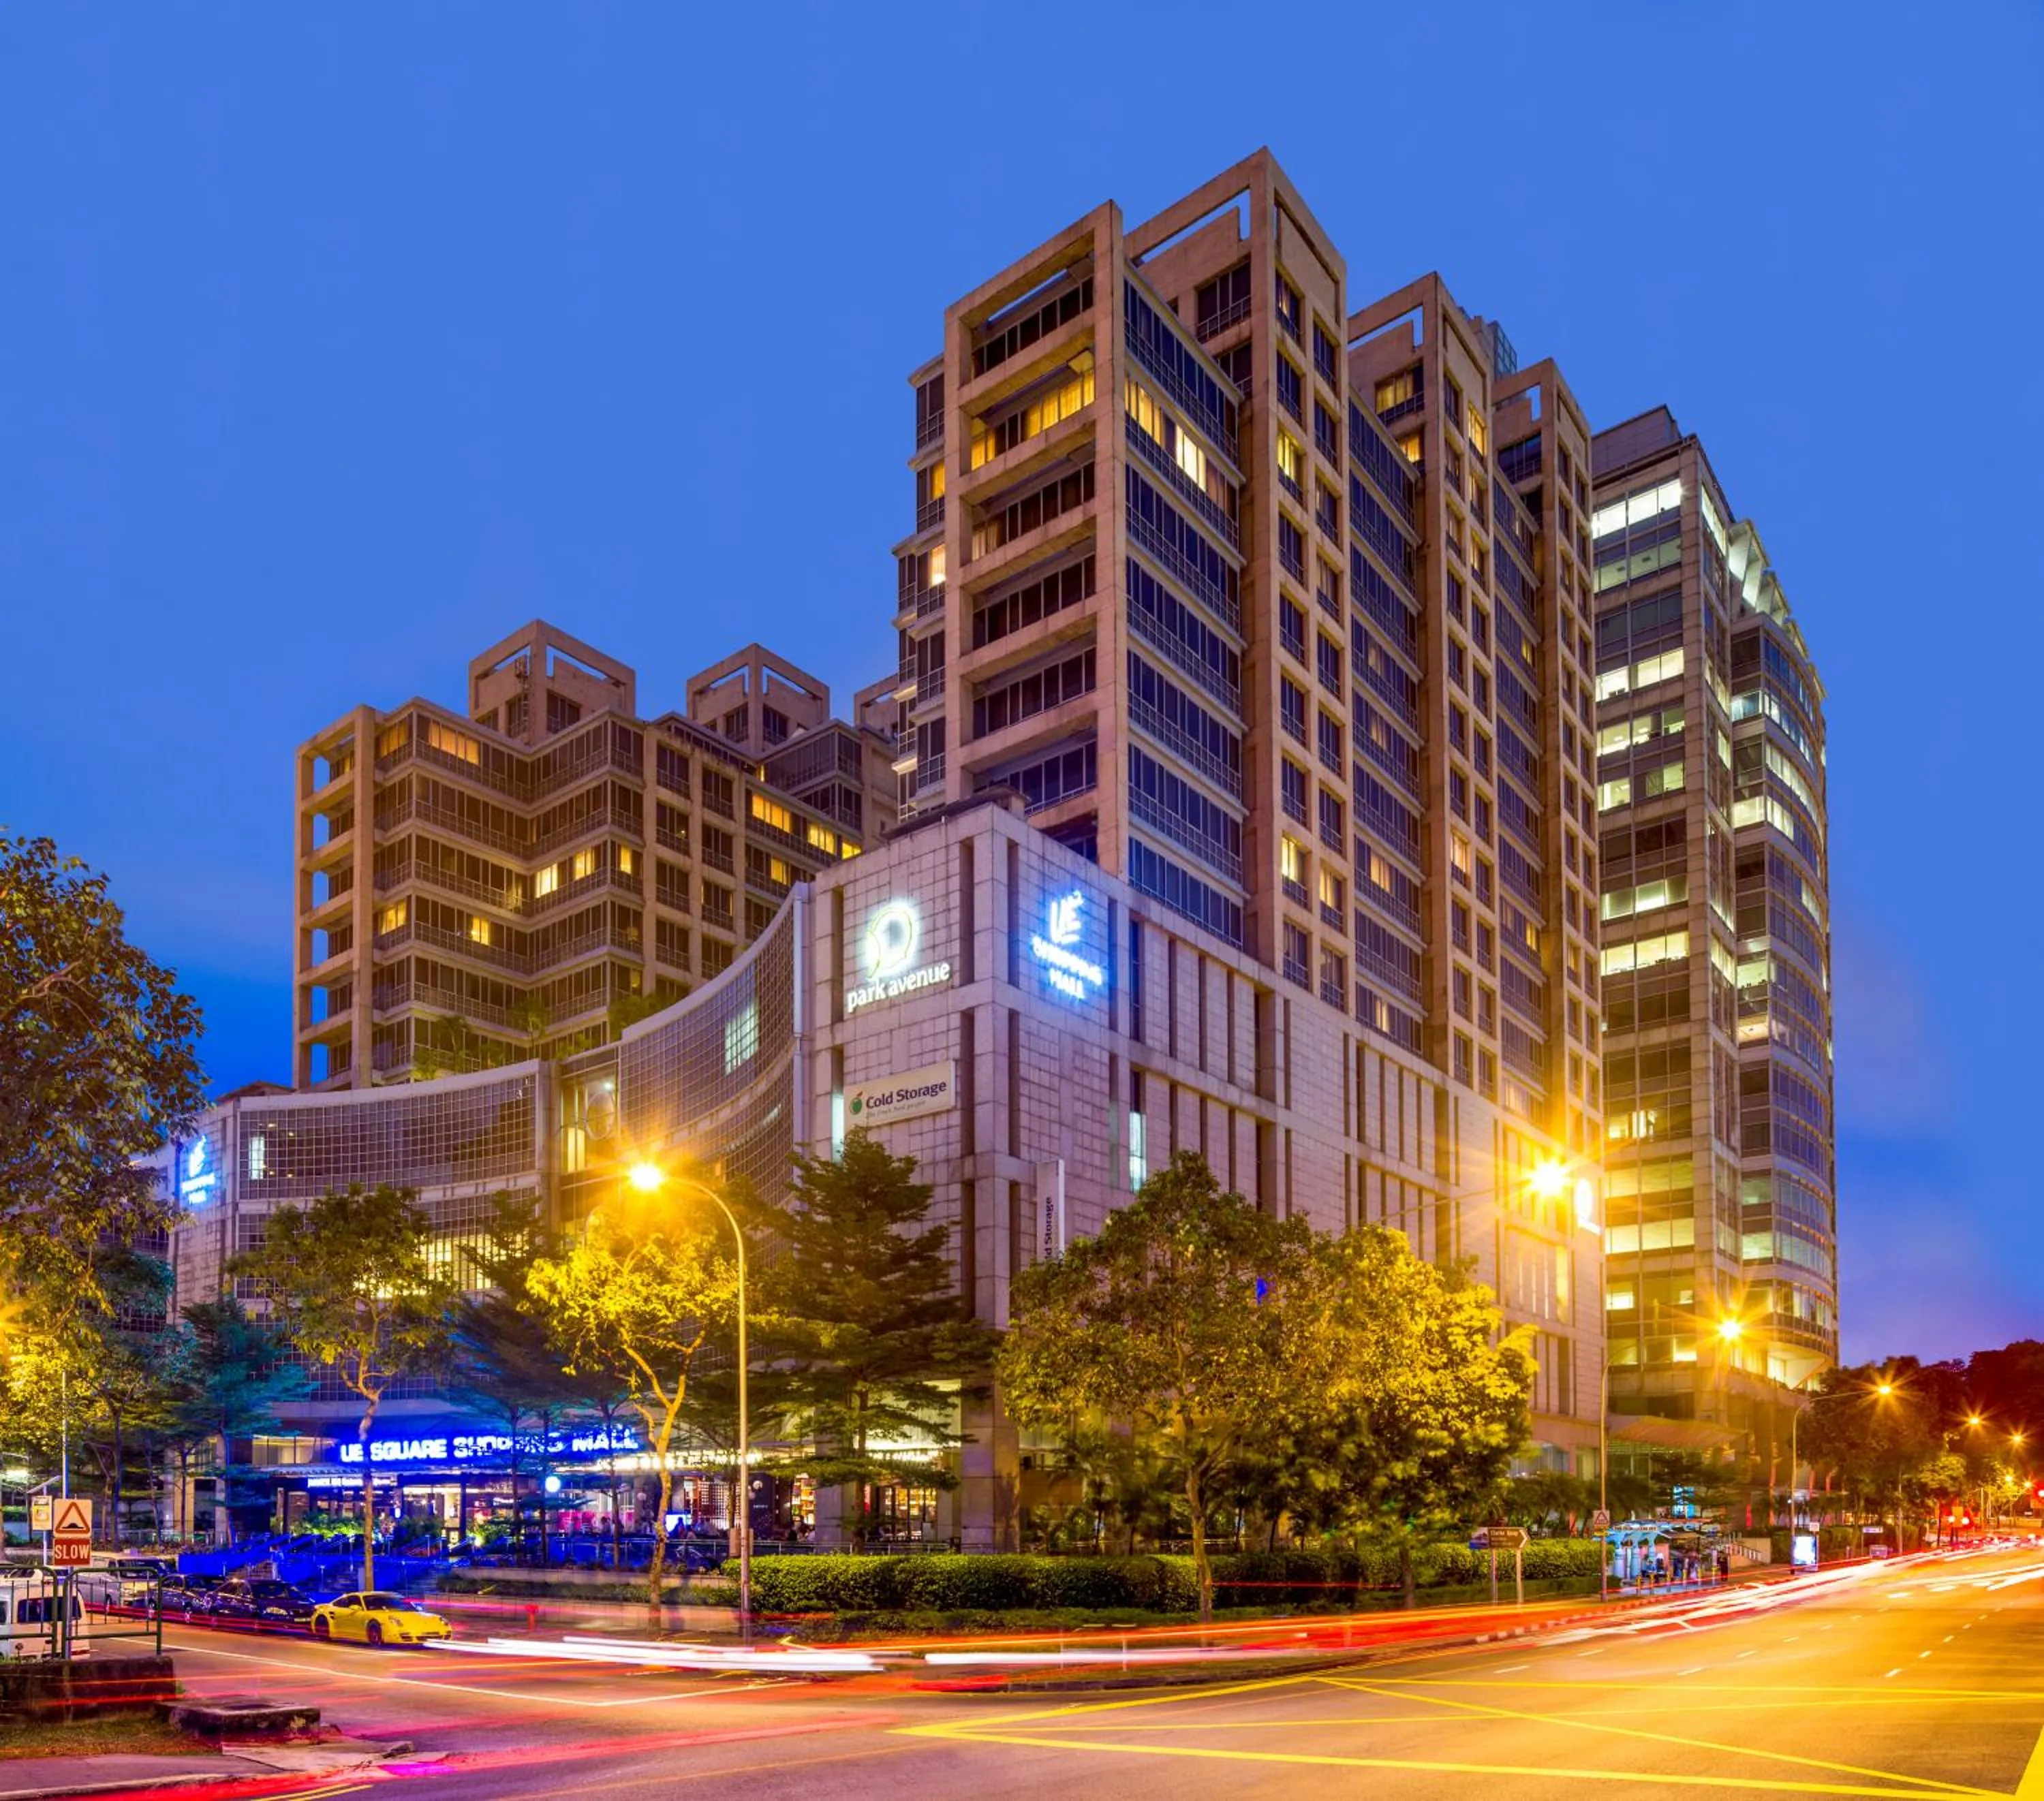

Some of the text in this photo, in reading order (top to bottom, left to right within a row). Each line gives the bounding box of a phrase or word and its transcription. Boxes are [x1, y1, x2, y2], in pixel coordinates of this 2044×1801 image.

[848, 962, 950, 1014] park avenue
[866, 1082, 946, 1109] Cold Storage
[1044, 1197, 1053, 1245] Storage
[341, 1443, 363, 1462] UE
[370, 1439, 447, 1461] SQUARE
[55, 1544, 89, 1559] SLOW
